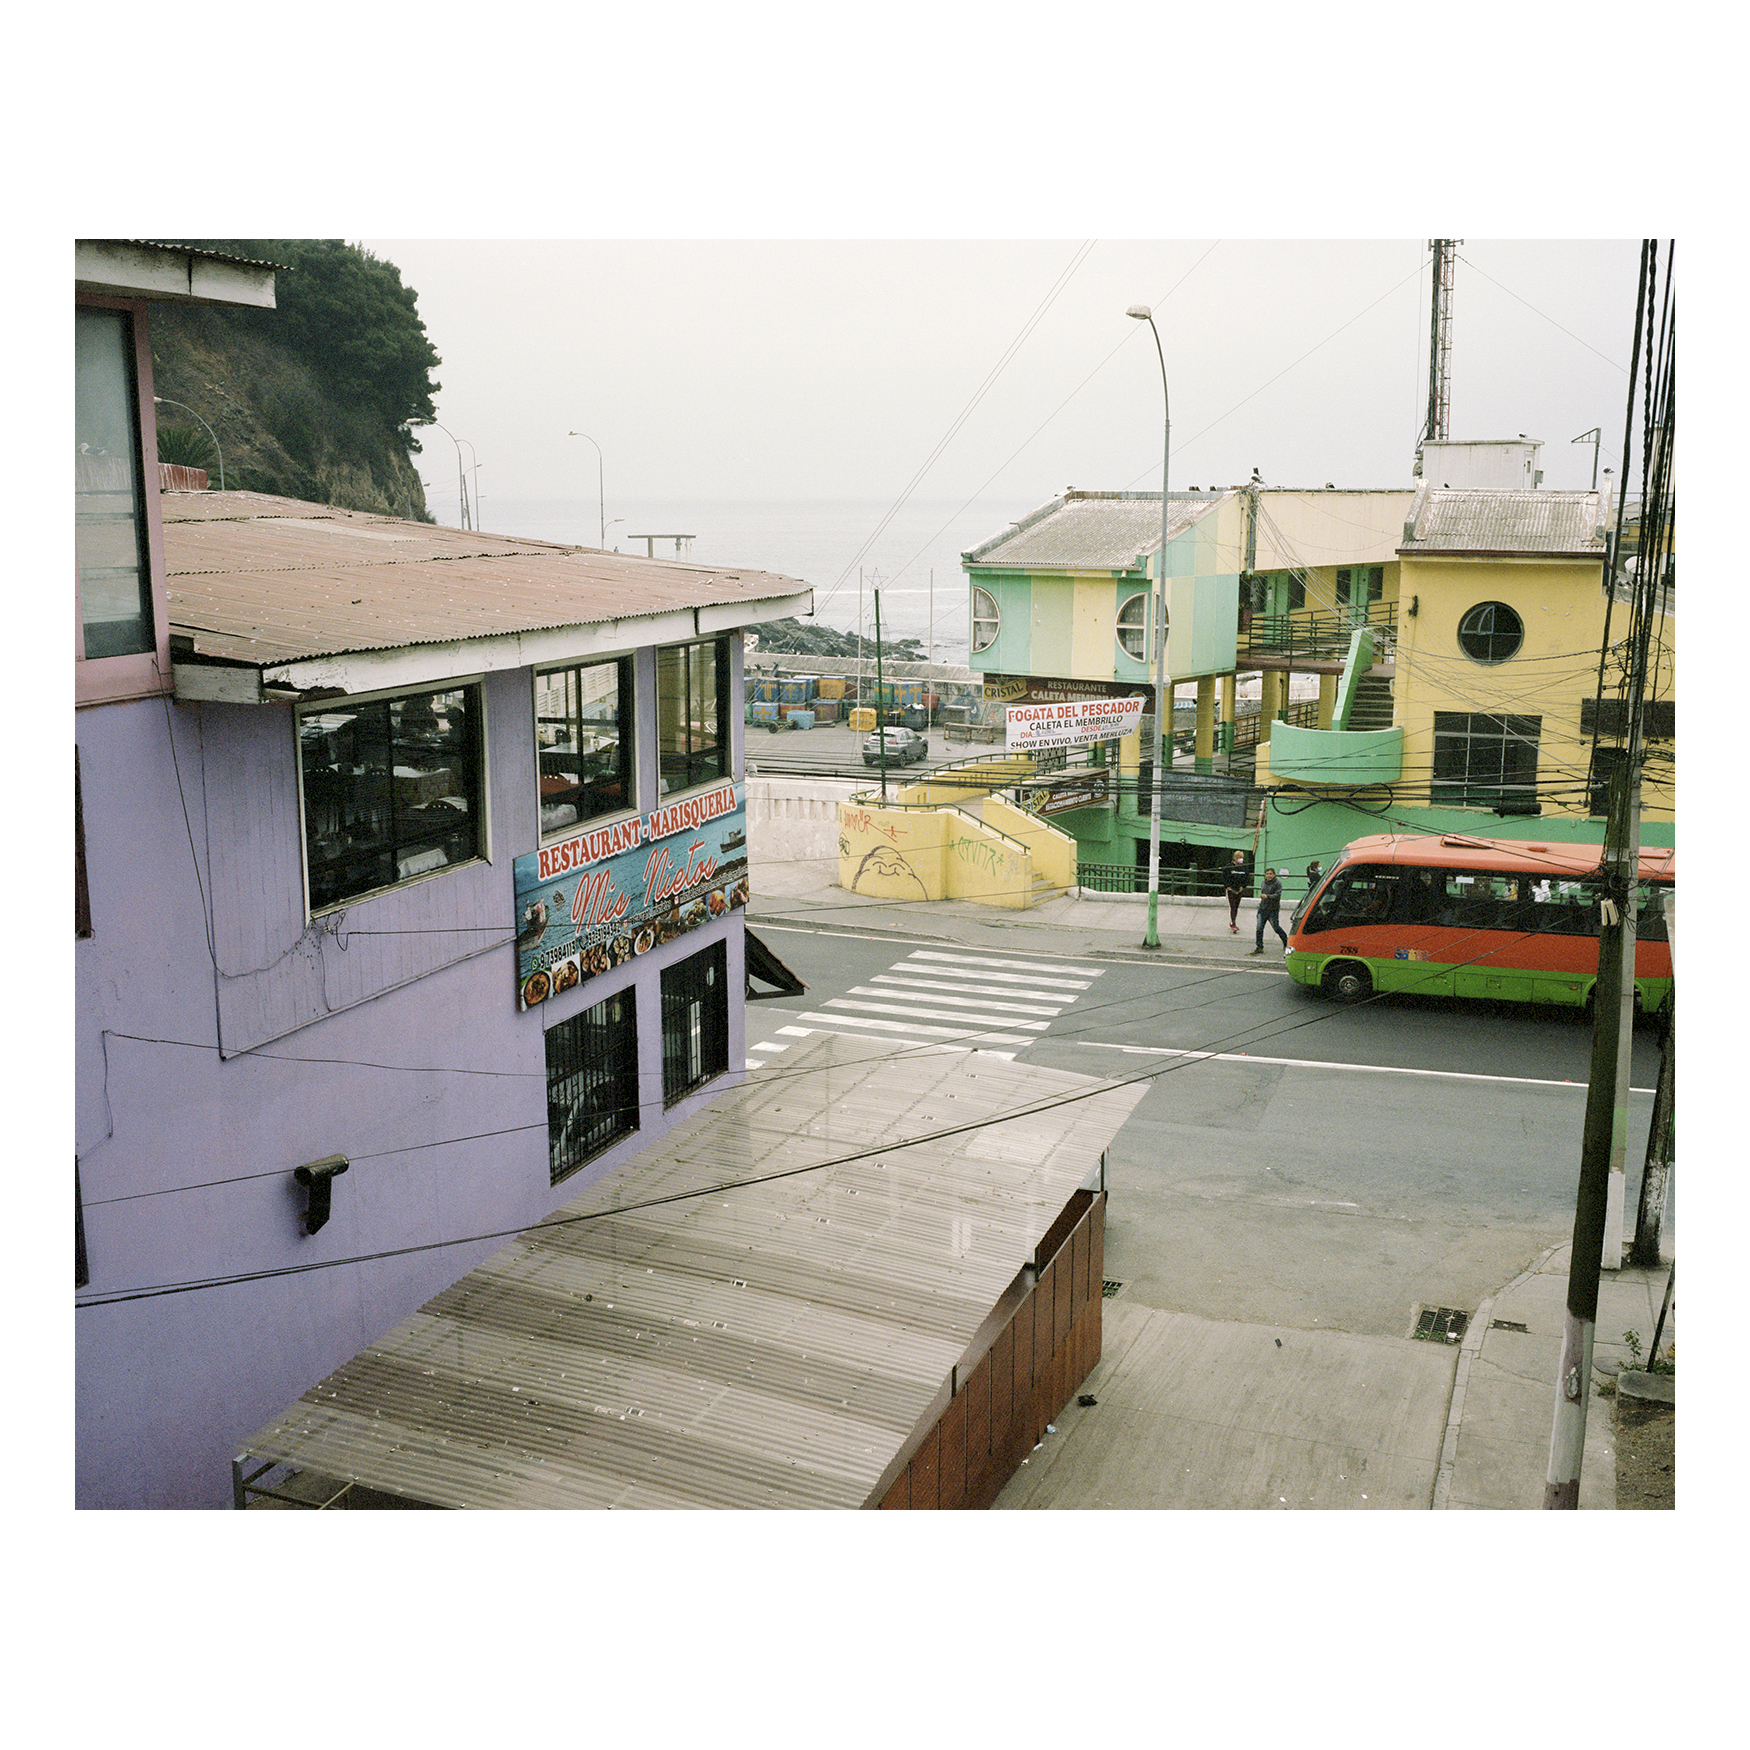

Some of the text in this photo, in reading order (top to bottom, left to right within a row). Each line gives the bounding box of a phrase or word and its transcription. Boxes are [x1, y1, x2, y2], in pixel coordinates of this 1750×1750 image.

[984, 680, 1024, 698] CRISTAL
[1031, 690, 1066, 702] CALETA
[1047, 681, 1107, 693] RESTAURANTE
[1008, 701, 1140, 723] FOGATA DEL PESCADOR
[1029, 720, 1062, 731] CALETA
[1064, 719, 1073, 728] EL
[1075, 714, 1123, 727] MEMBRILLO
[1081, 725, 1101, 733] DESDE
[1010, 740, 1038, 750] SHOW
[1039, 739, 1050, 748] EN
[1074, 733, 1098, 743] VENTA
[1099, 728, 1133, 739] MERLUZA
[538, 818, 641, 880] RESTAURANT
[649, 786, 737, 840] MARISQUERIA
[571, 869, 631, 935] Mis
[643, 838, 718, 907] Nietos
